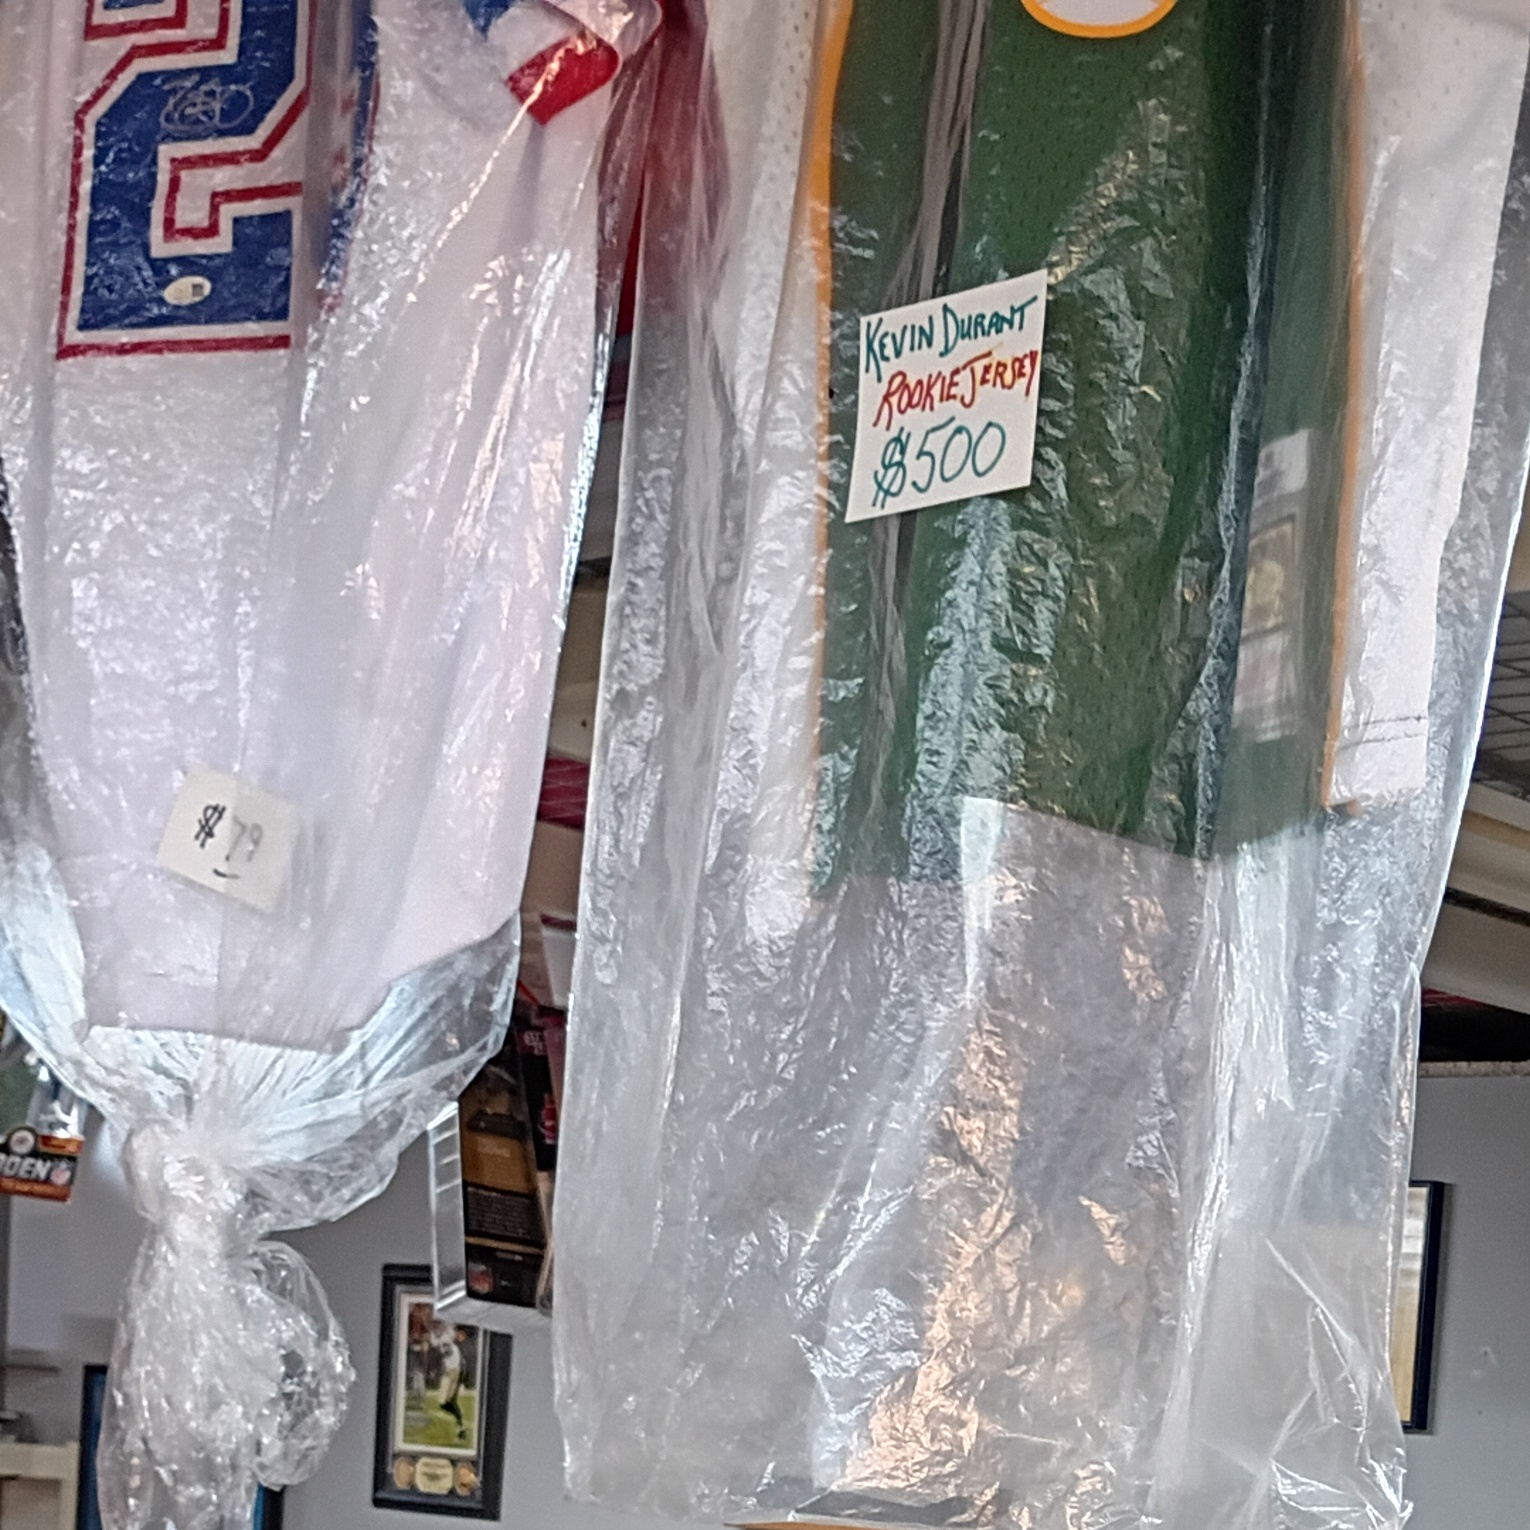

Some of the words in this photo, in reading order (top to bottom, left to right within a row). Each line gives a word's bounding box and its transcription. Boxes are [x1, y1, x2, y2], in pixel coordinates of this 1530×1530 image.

[863, 315, 935, 383] KEVIN
[939, 294, 1038, 358] DURANT
[872, 366, 963, 432] ROOKIE
[960, 349, 1039, 409] JERSEY
[871, 416, 1007, 510] $500
